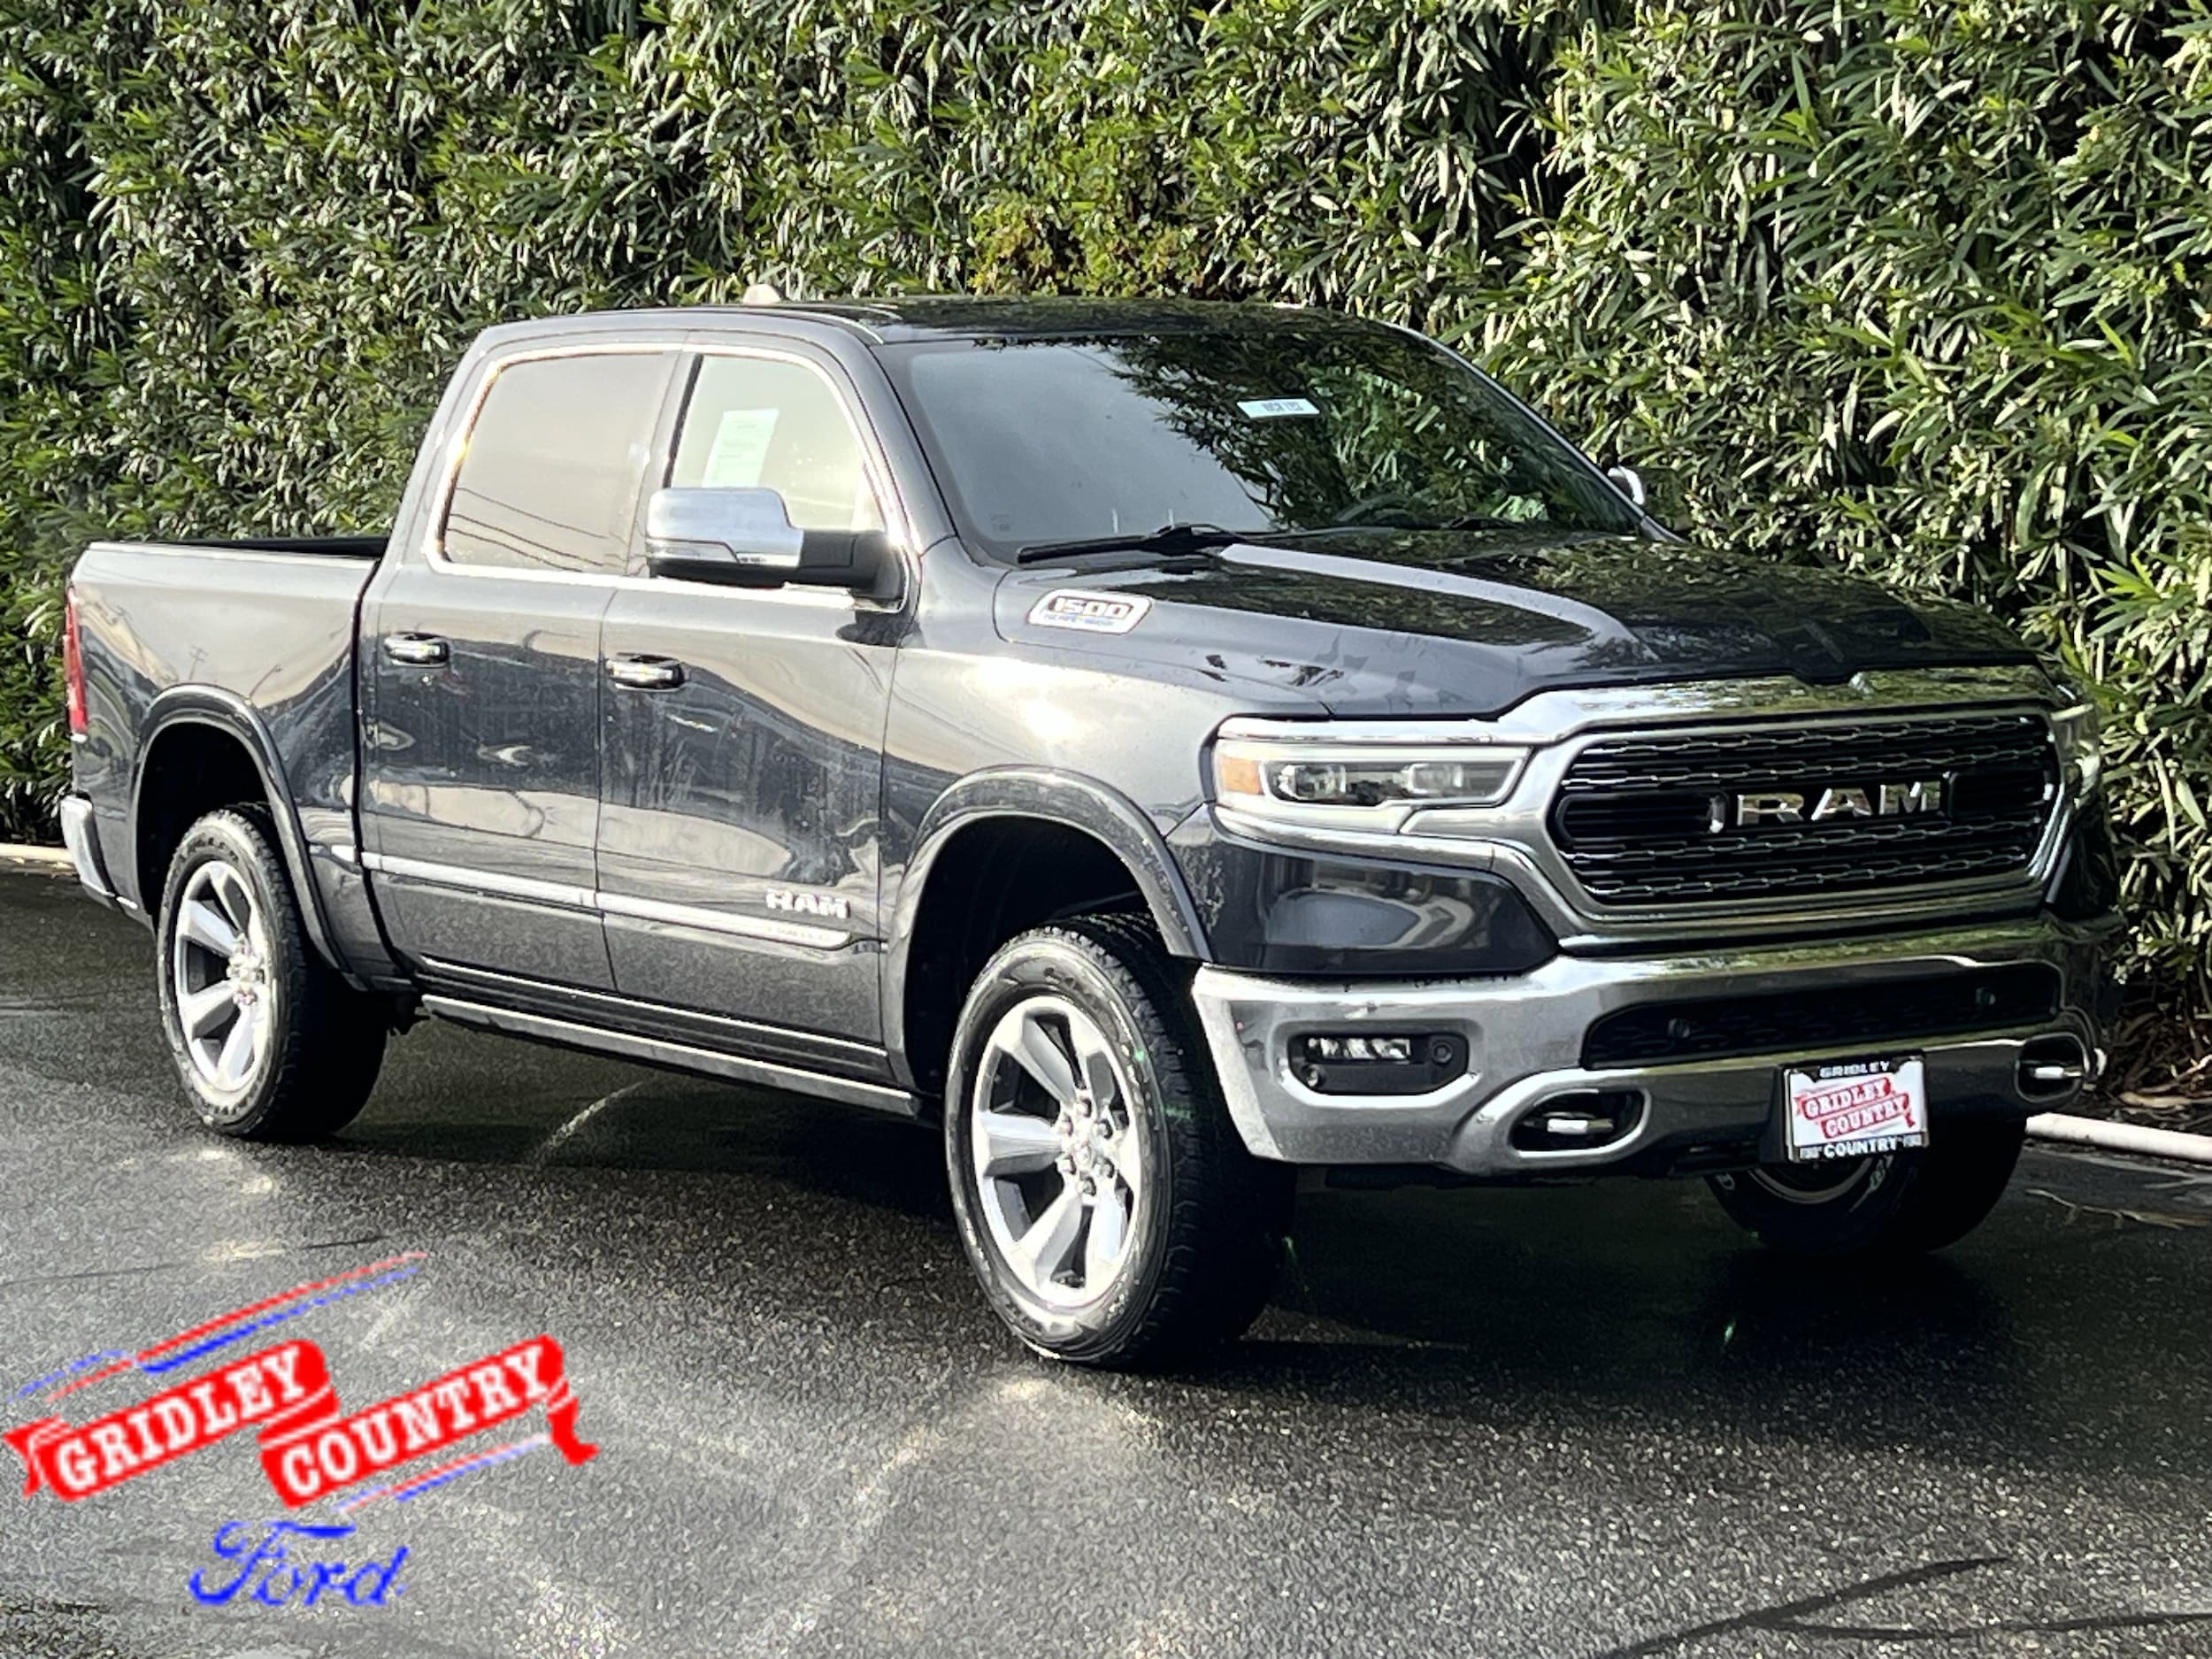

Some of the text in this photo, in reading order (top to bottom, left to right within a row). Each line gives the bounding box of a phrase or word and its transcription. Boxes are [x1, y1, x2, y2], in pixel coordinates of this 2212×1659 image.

[1053, 597, 1131, 619] 1500
[1736, 780, 1941, 826] RAM
[765, 888, 850, 918] RAM
[1819, 1061, 1891, 1079] GRIDLEY
[1804, 1079, 1886, 1118] GRIDLEY
[1824, 1096, 1905, 1137] COUNTRY
[1824, 1136, 1898, 1158] COUNTRY
